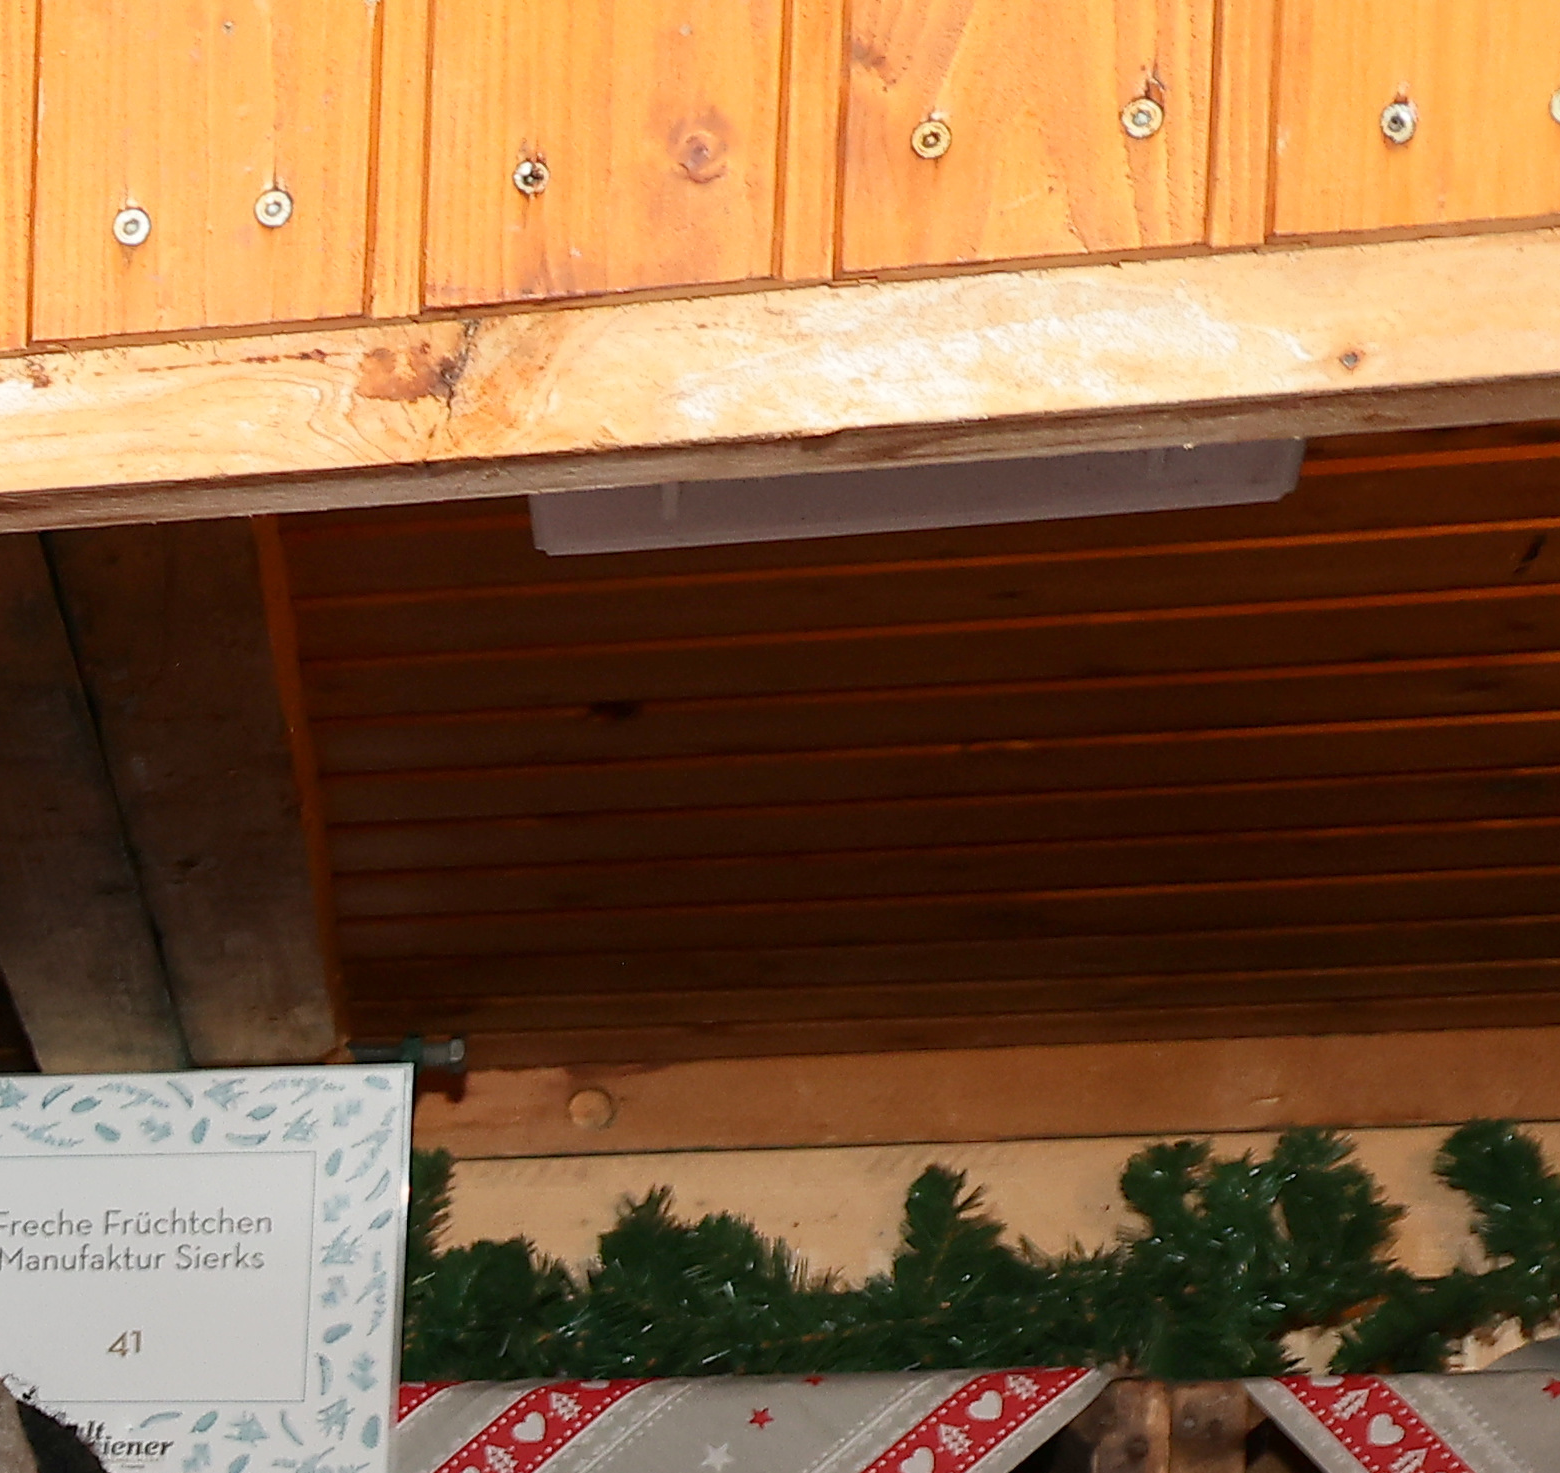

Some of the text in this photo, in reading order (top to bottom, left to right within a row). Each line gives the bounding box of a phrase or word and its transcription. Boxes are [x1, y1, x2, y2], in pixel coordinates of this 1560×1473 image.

[103, 1208, 273, 1237] Früchtchen
[176, 1243, 265, 1271] Sierks
[107, 1330, 144, 1358] 41
